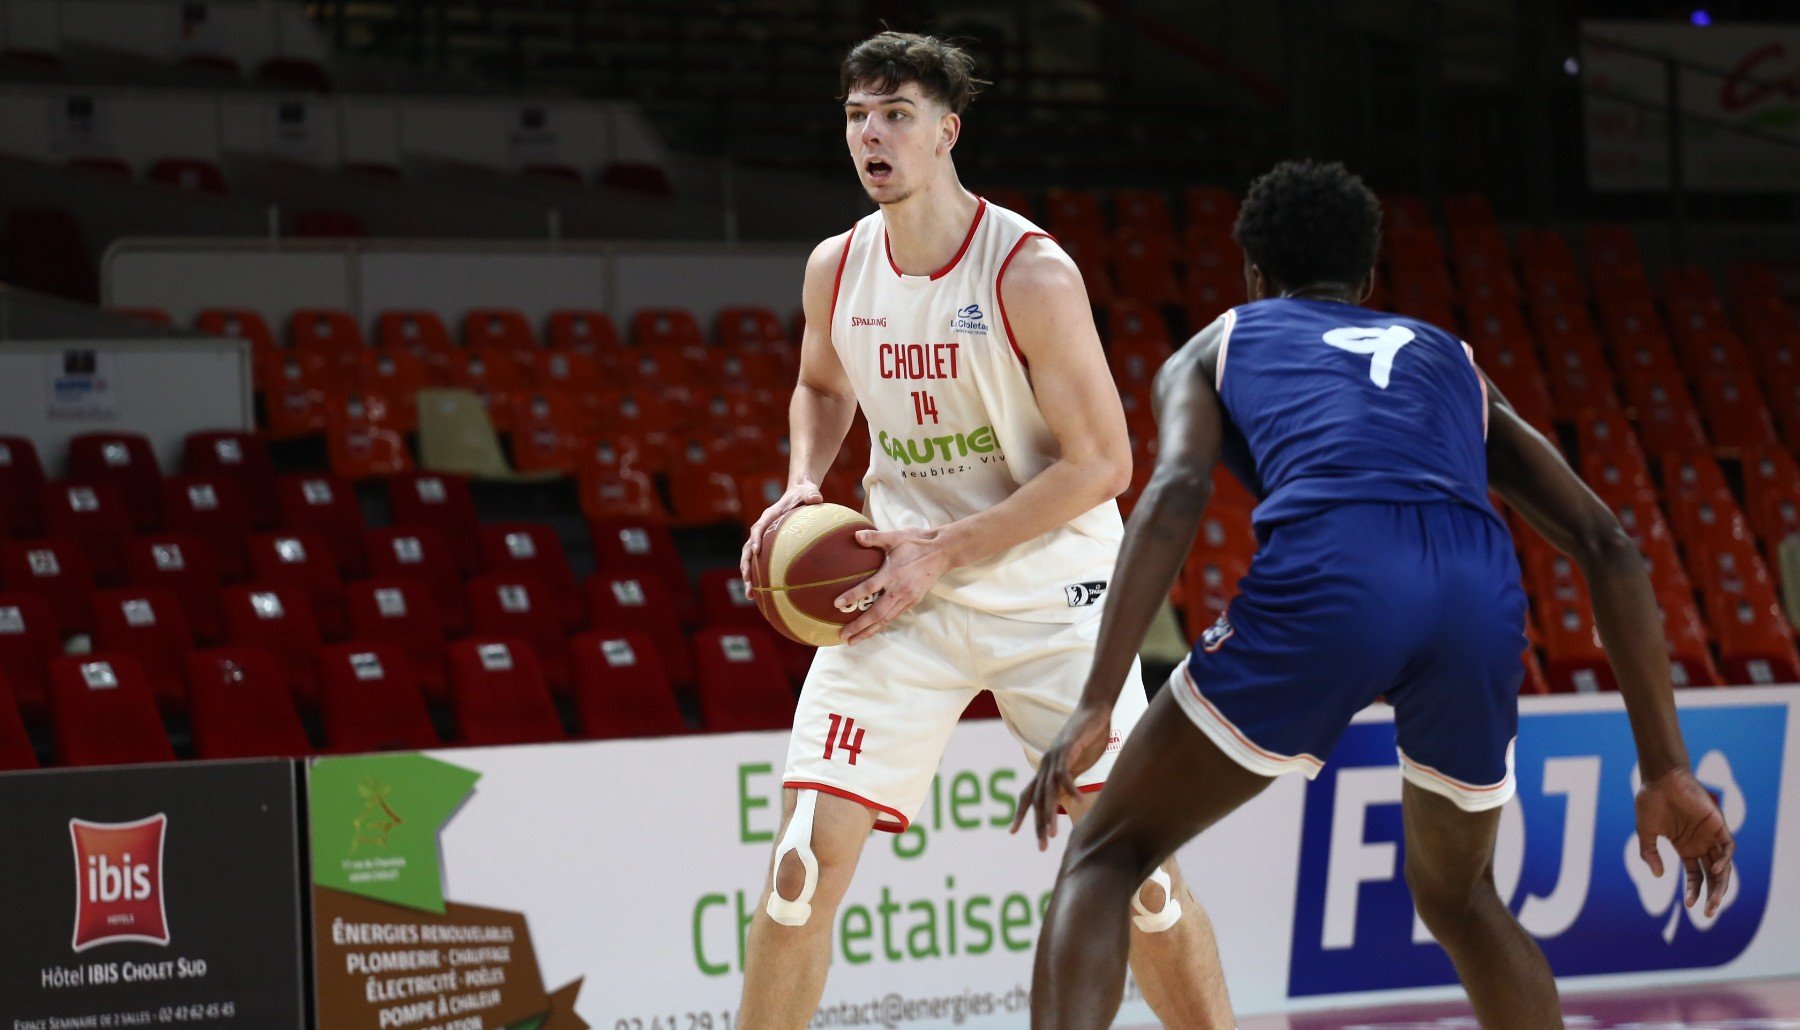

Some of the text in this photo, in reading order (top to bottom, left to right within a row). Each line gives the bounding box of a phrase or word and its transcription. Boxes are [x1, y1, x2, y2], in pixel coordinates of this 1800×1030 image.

[879, 343, 959, 380] CHOLET
[1322, 325, 1415, 389] 9
[911, 390, 939, 426] 14
[980, 455, 1006, 464] Viv
[823, 713, 866, 766] 14
[88, 852, 152, 904] ibis
[332, 916, 420, 945] ÉNERGIES
[41, 966, 84, 988] Hôtel
[88, 963, 118, 984] IBIS
[346, 949, 440, 975] PLOMBERIE
[379, 1001, 437, 1030] POMPE
